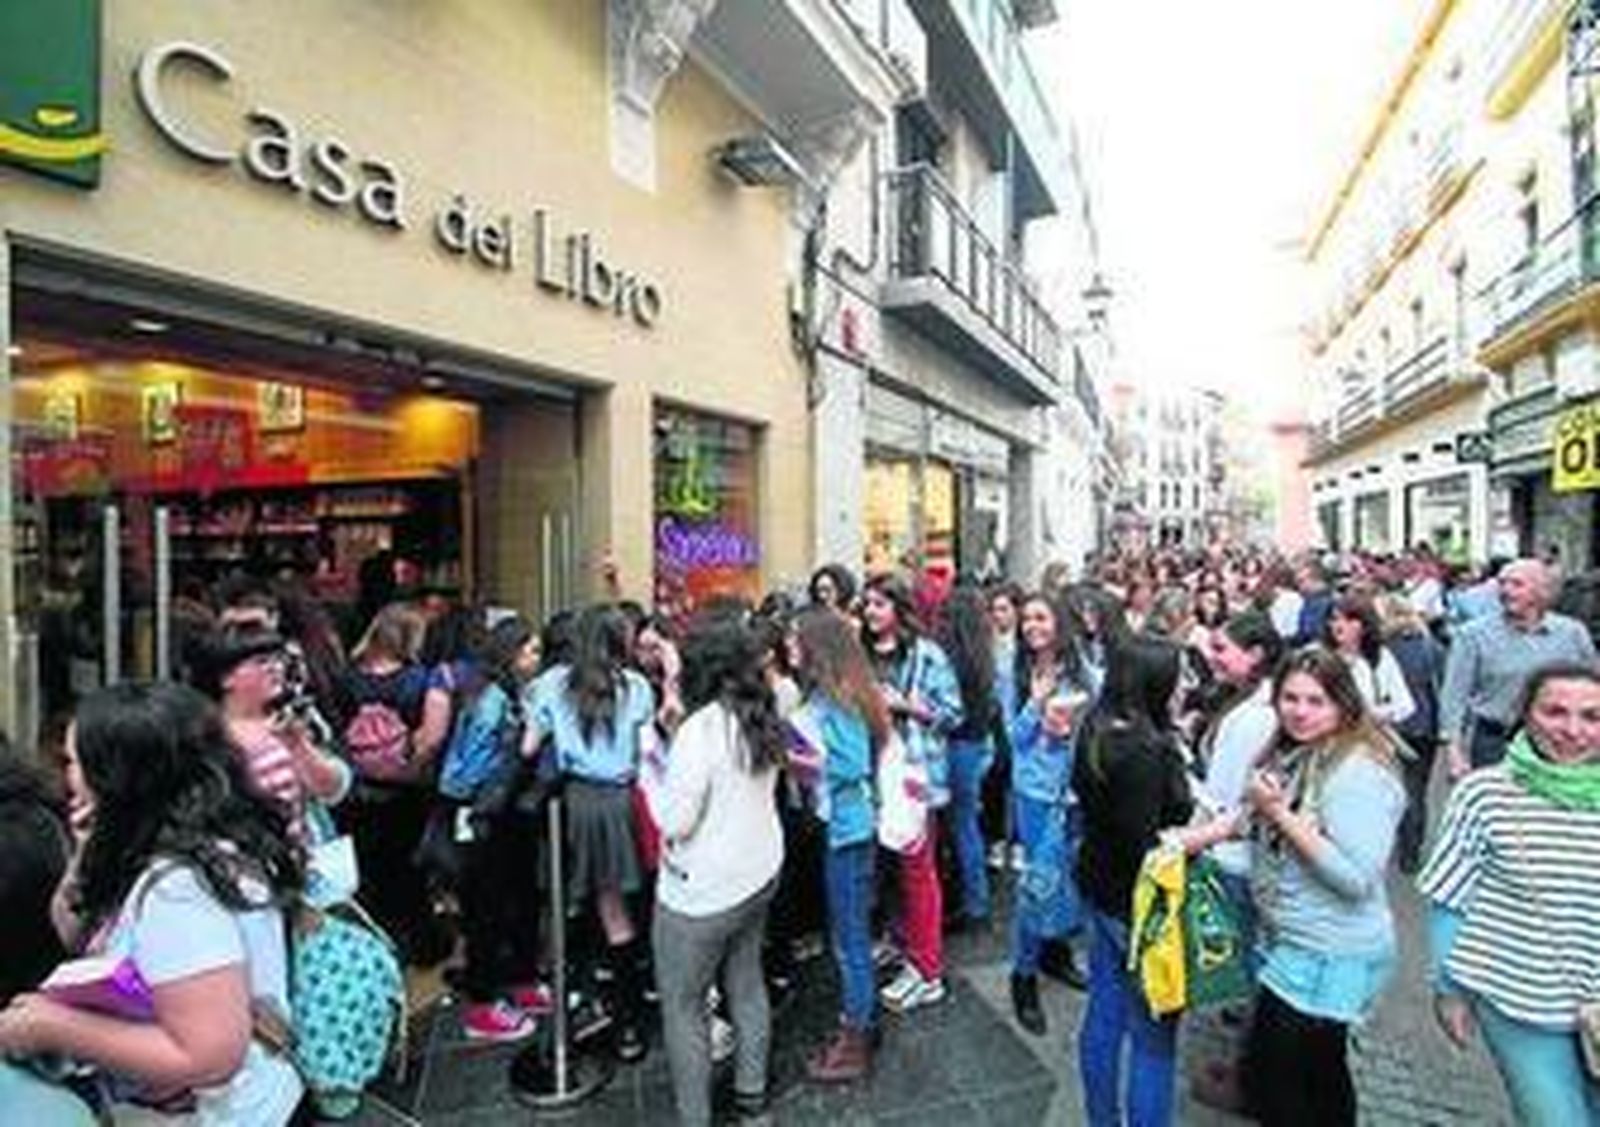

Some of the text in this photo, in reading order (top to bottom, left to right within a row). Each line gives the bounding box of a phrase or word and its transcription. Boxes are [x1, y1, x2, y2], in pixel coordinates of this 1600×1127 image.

[132, 39, 663, 328] Casa del Libro
